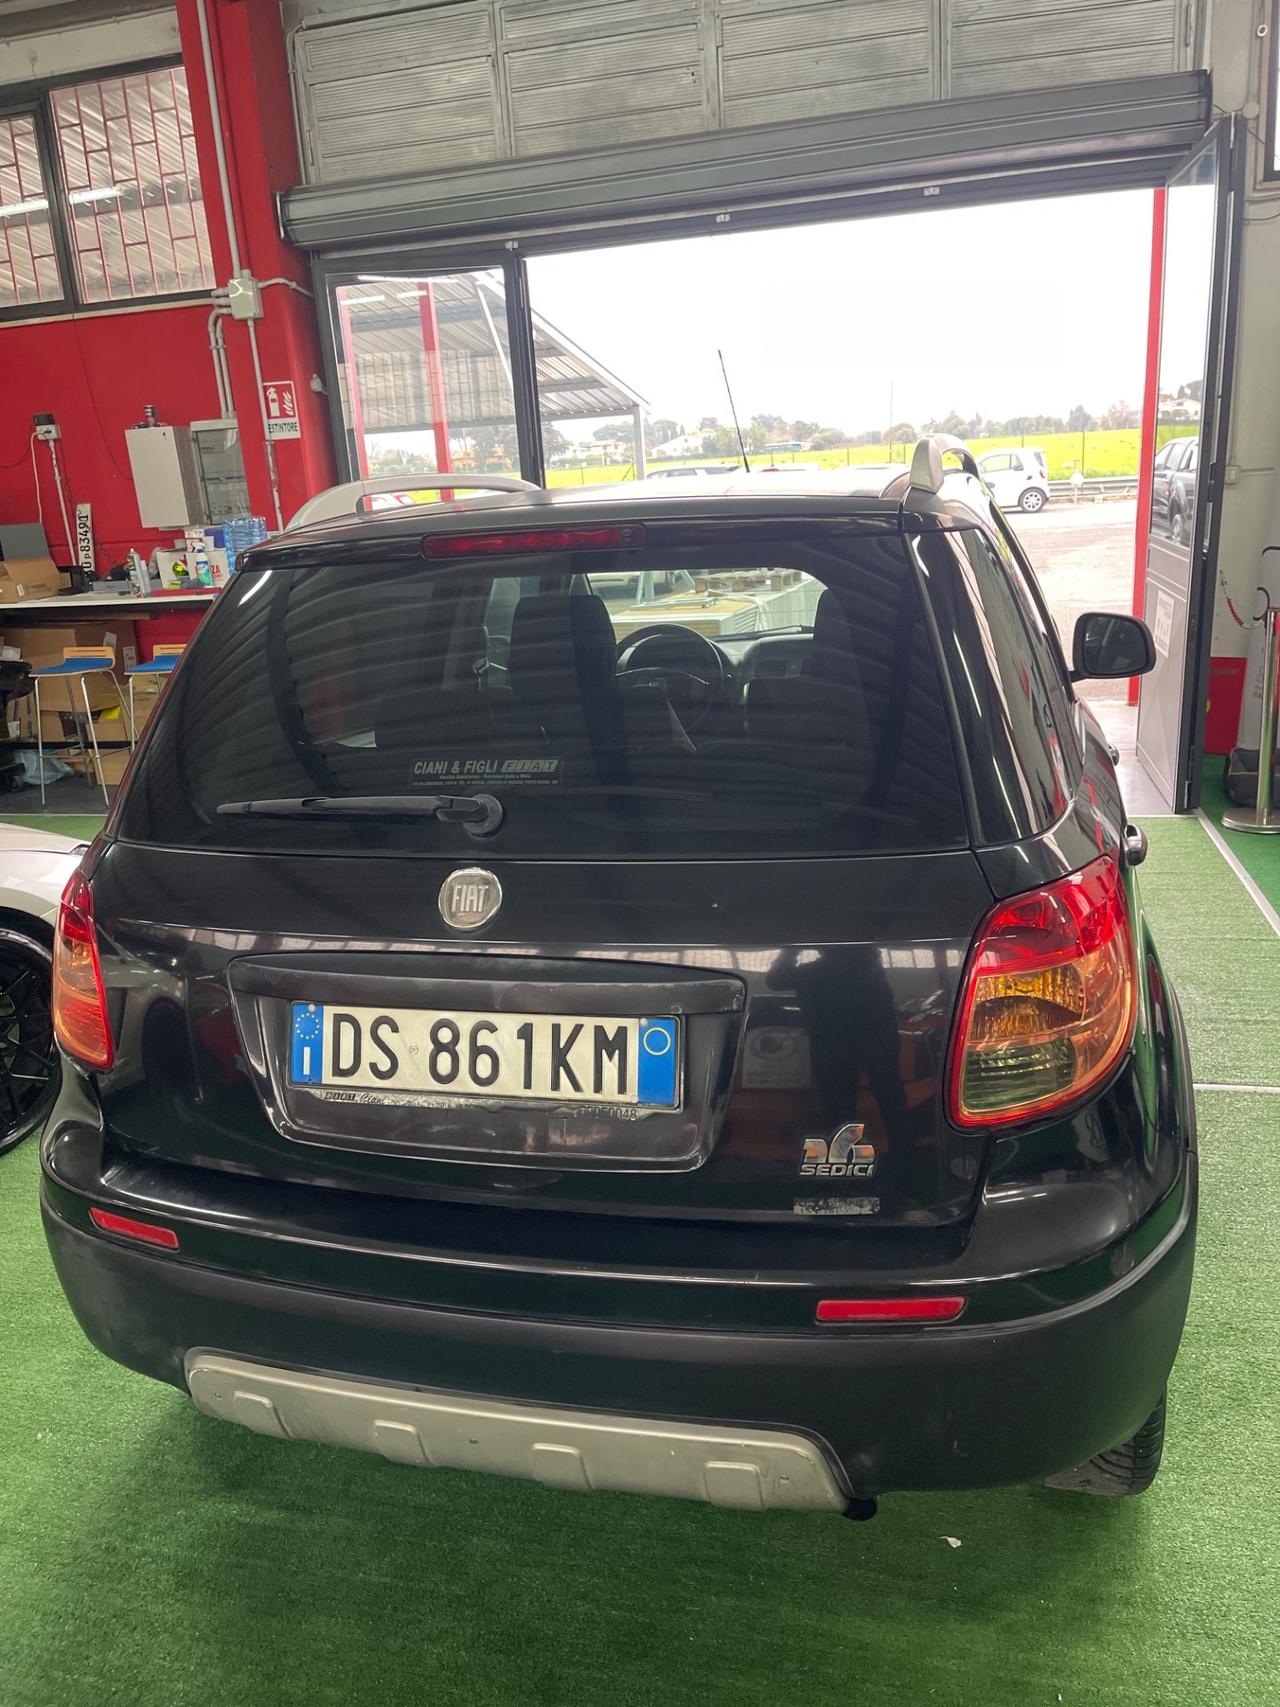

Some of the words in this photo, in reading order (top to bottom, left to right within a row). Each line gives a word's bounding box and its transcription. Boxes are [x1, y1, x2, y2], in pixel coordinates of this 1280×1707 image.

[267, 422, 299, 434] ESTINTORE
[414, 761, 448, 774] CIANI
[451, 760, 460, 773] &
[463, 760, 498, 774] FIGLI
[500, 759, 558, 773] FIAT
[450, 884, 489, 912] FIAT
[331, 1012, 399, 1082] DS
[428, 1018, 628, 1096] 861KM
[800, 1164, 875, 1177] SEDICI
